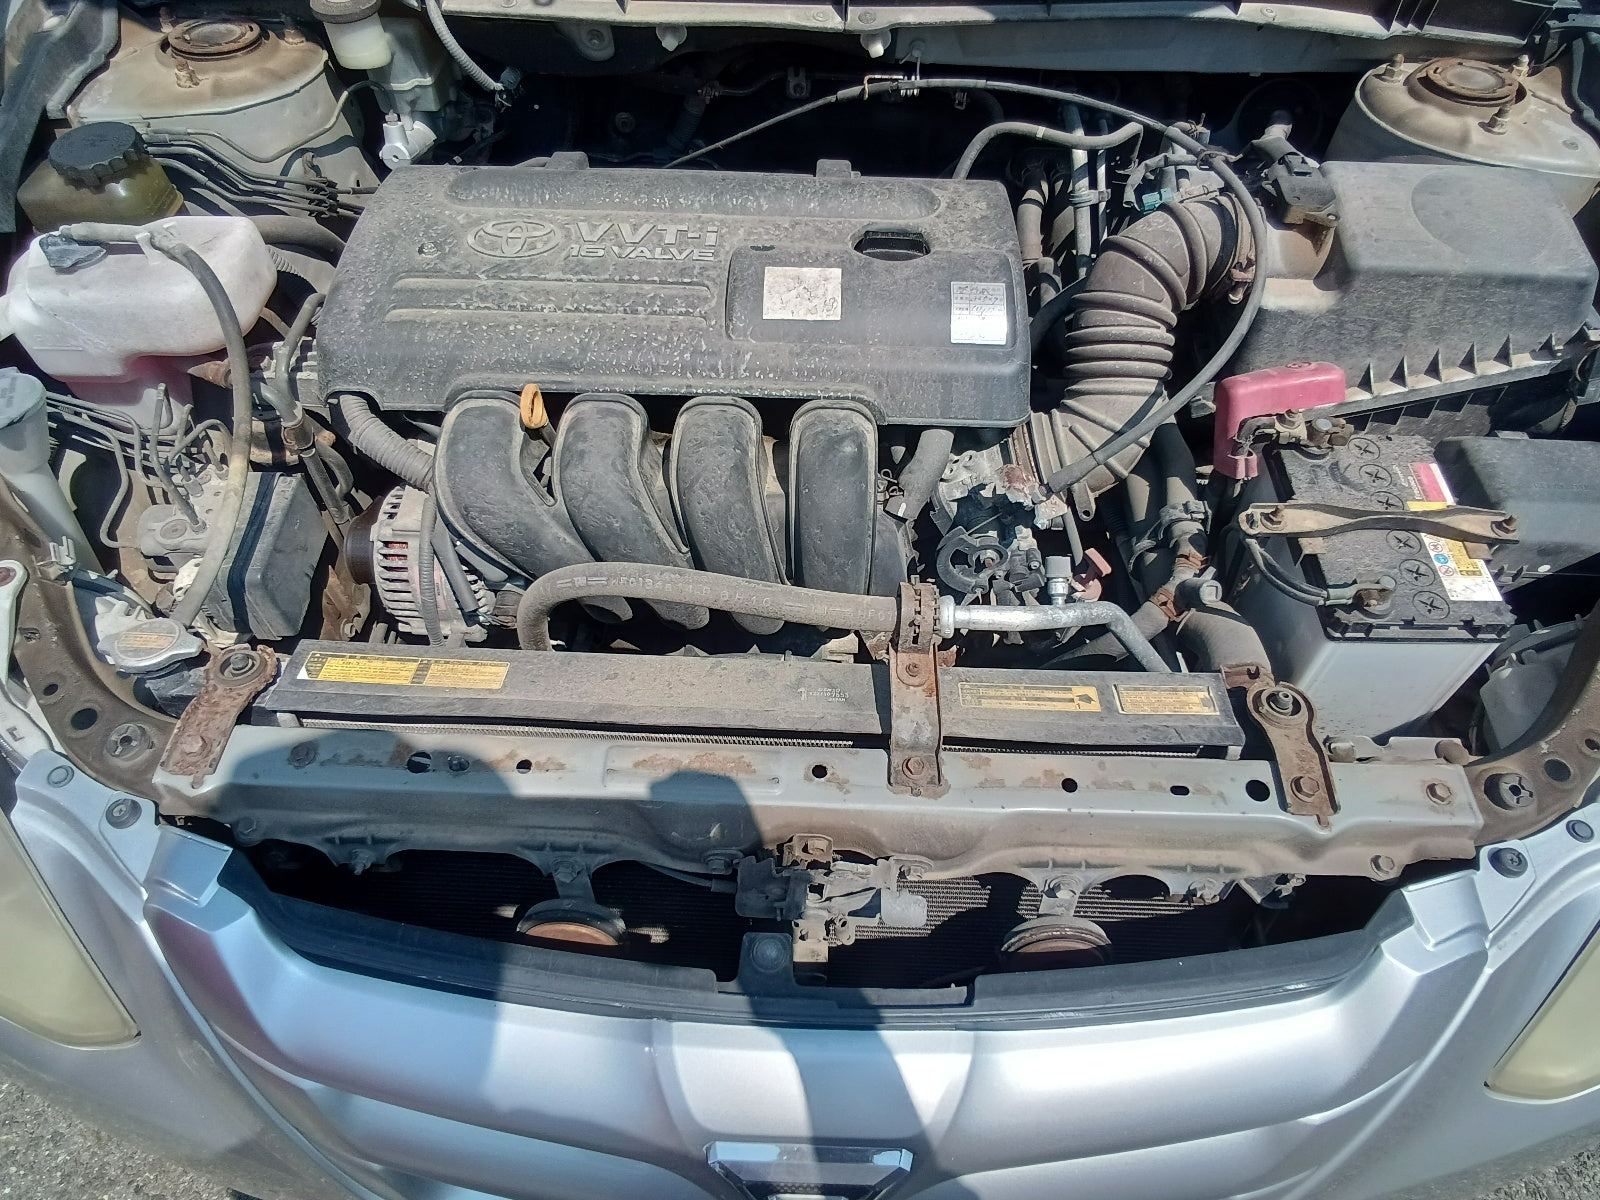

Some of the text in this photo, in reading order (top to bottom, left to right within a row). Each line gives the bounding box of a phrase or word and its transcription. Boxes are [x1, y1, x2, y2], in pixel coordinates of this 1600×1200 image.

[575, 222, 719, 247] VVT-i
[569, 244, 715, 262] 16 VALVE
